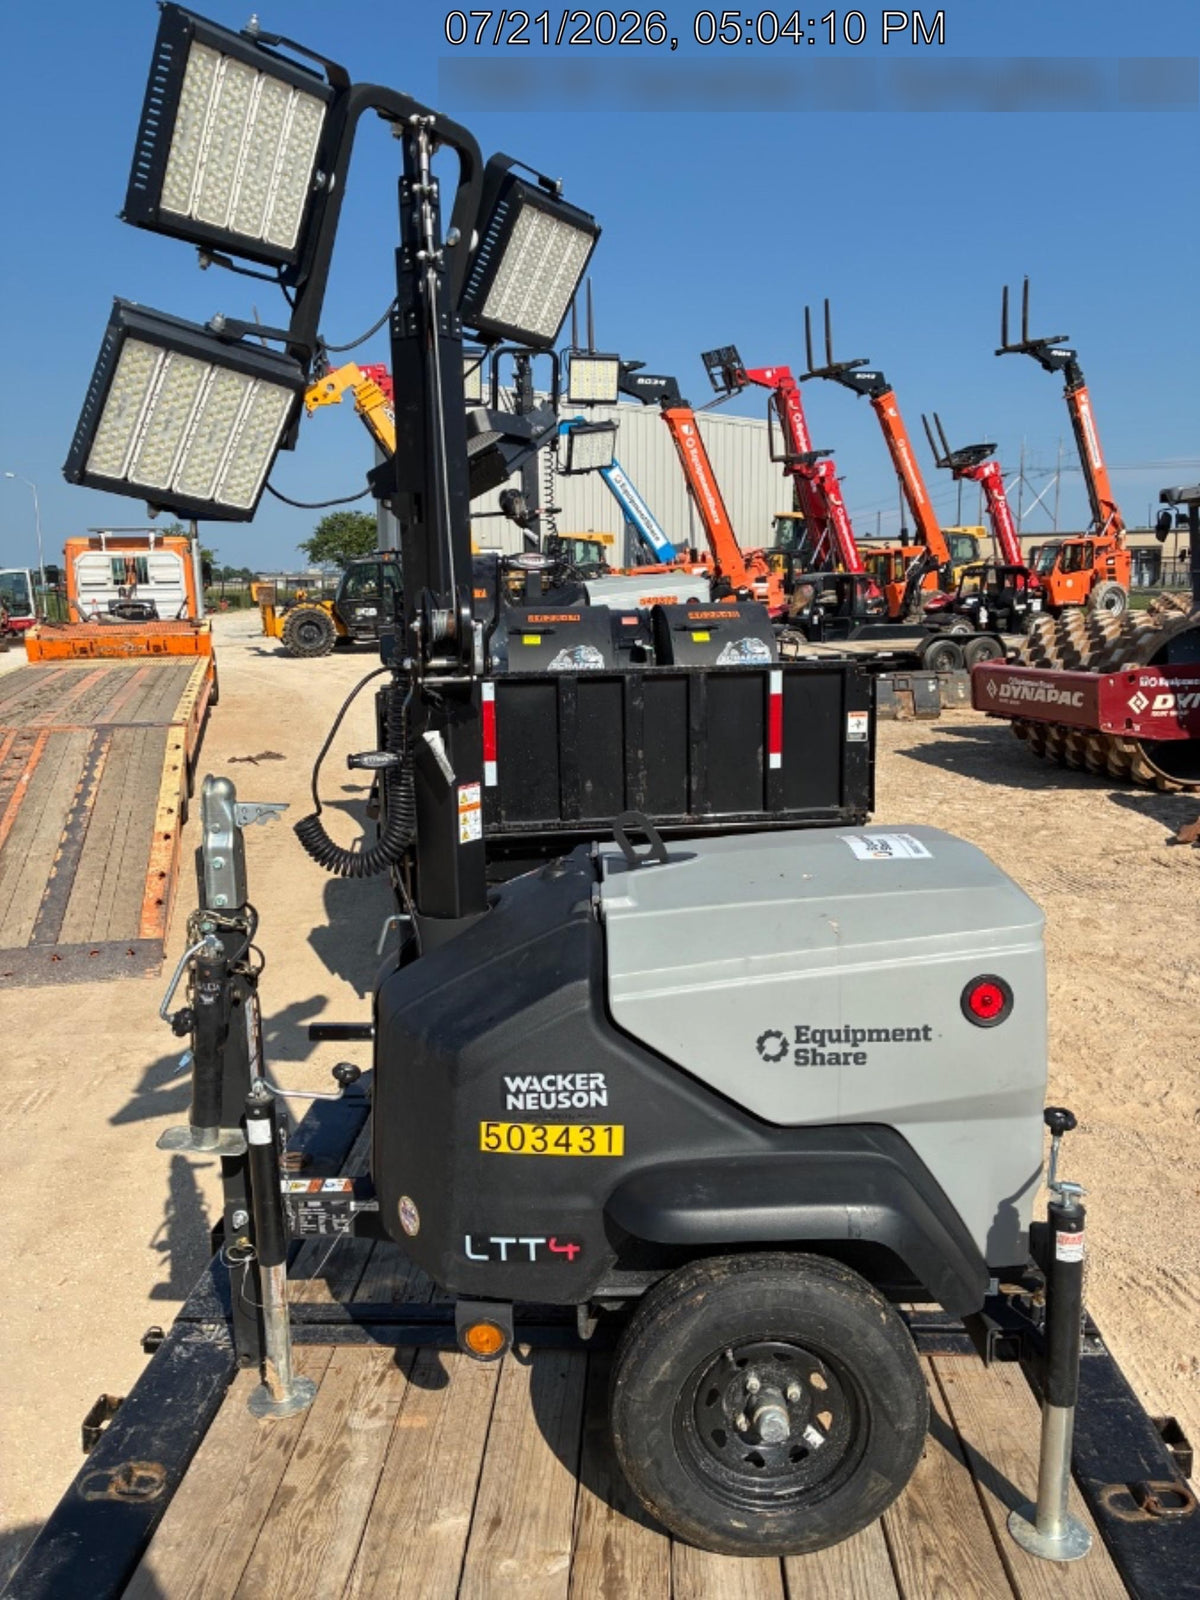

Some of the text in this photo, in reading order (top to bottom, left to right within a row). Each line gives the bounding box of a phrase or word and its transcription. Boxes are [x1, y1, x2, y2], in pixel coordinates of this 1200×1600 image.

[998, 683, 1085, 708] DYNAPAC
[794, 1024, 933, 1048] Equipment
[794, 1048, 868, 1067] Share
[503, 1072, 608, 1092] WACKER
[506, 1090, 608, 1111] NEUSON
[484, 1123, 613, 1154] 503431
[465, 1234, 581, 1262] LTT4
